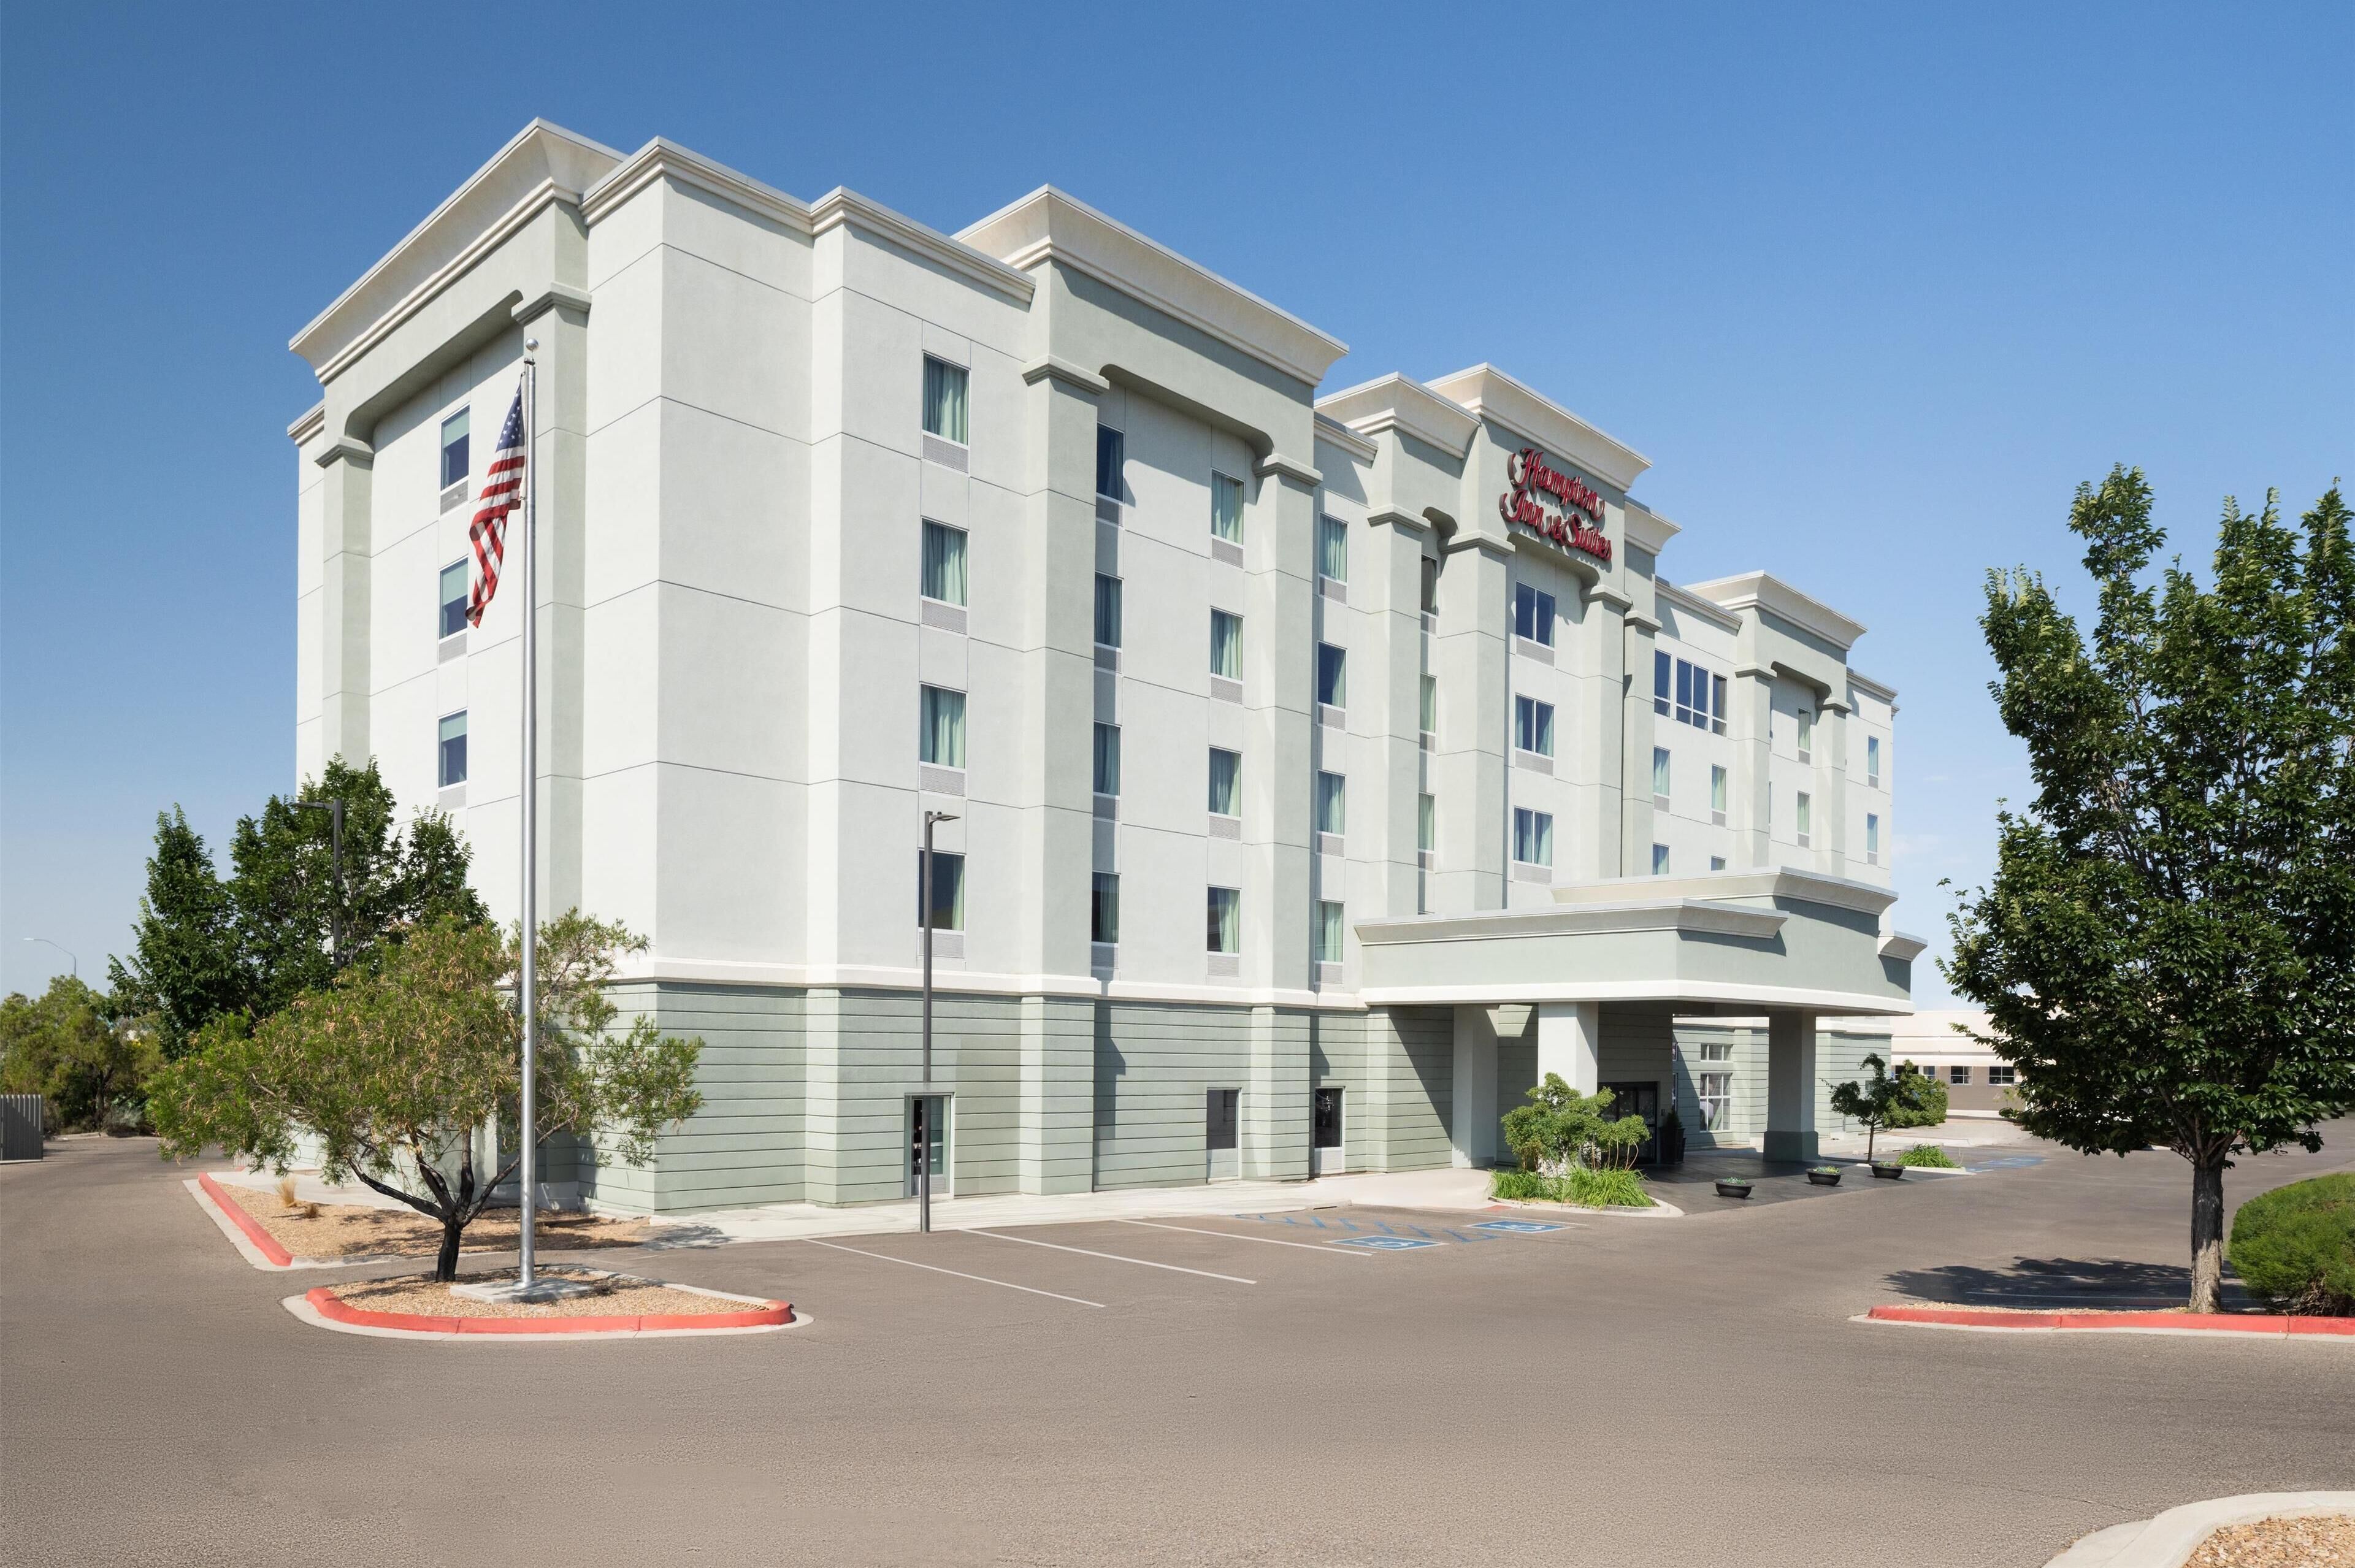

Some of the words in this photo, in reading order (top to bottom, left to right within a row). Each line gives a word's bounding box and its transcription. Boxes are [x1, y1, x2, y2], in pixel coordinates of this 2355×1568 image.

[1507, 448, 1606, 521] Hampton
[1499, 489, 1552, 537] Inn
[1552, 515, 1566, 546] &
[1561, 514, 1612, 561] Suites
